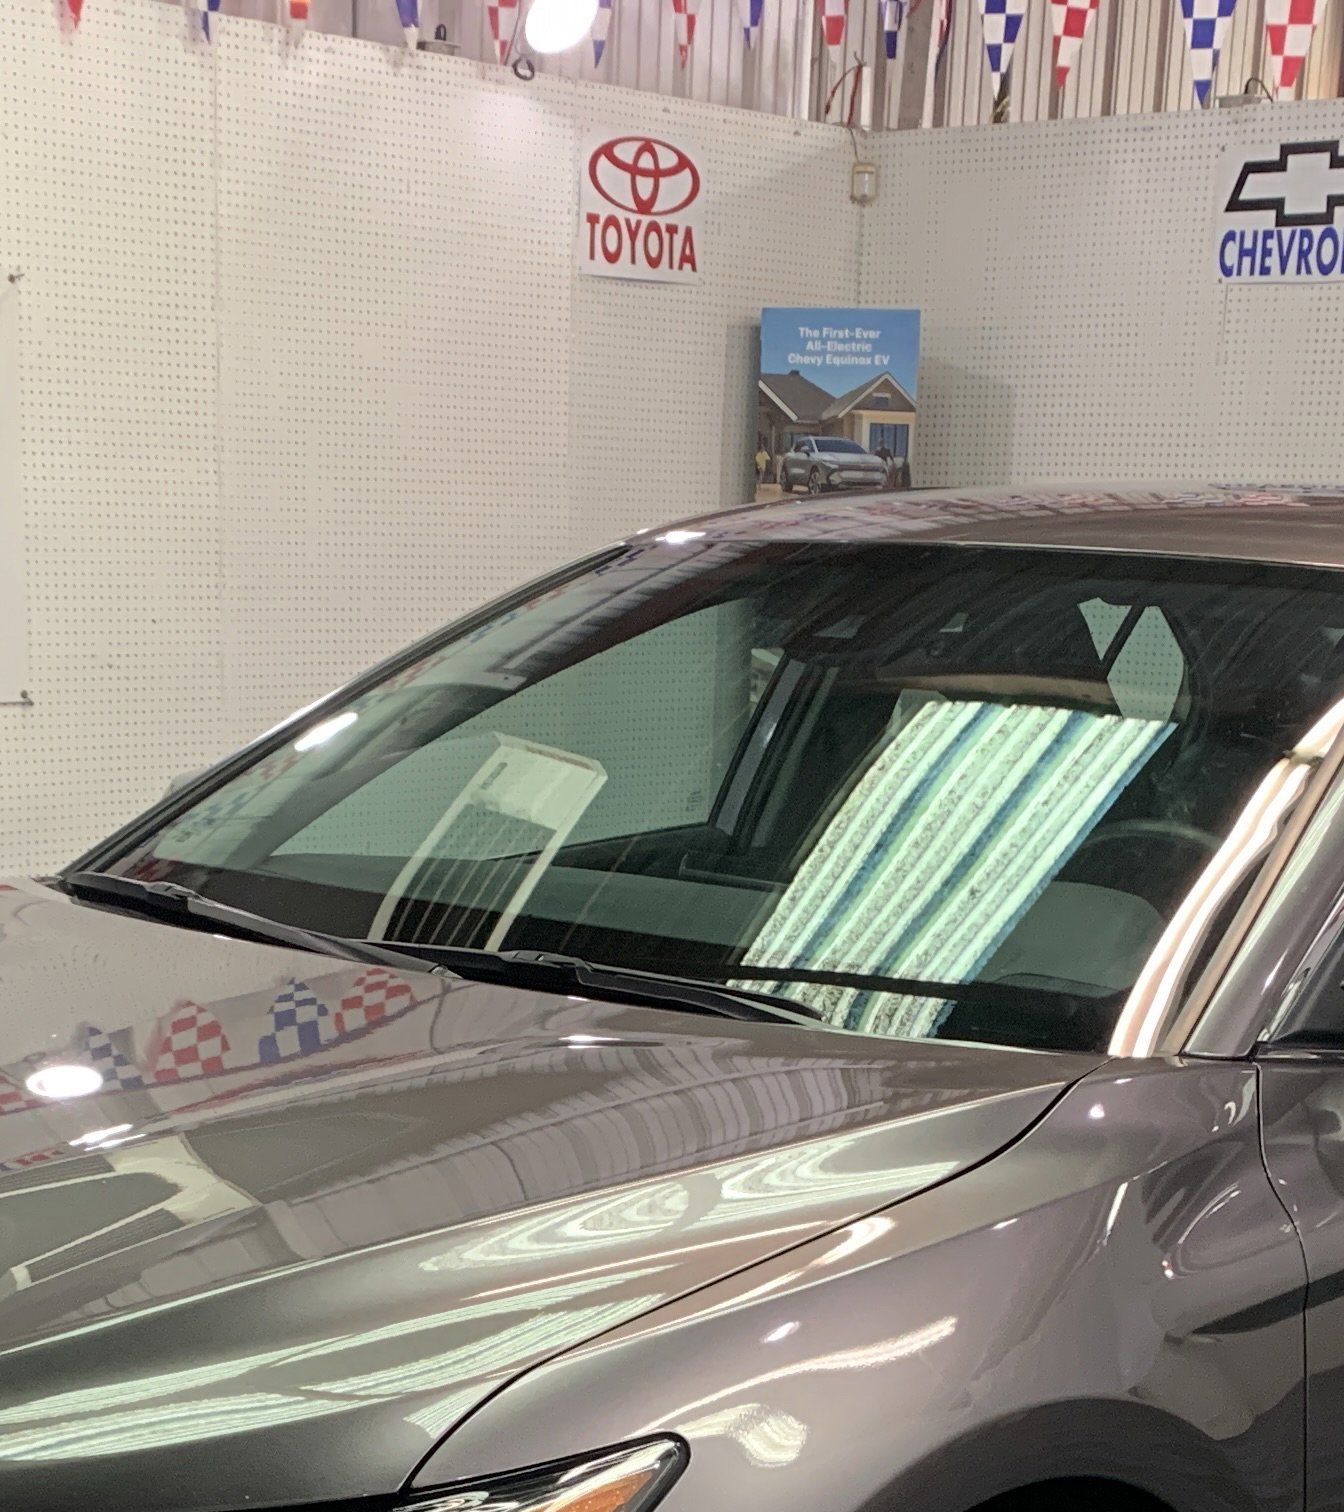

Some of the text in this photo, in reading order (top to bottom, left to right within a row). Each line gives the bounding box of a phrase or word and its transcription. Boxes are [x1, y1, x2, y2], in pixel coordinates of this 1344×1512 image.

[586, 212, 698, 273] TOYOTA
[798, 327, 882, 339] The First-Ever
[806, 340, 873, 353] All-Electric
[787, 353, 890, 367] Chevy Equinox EV
